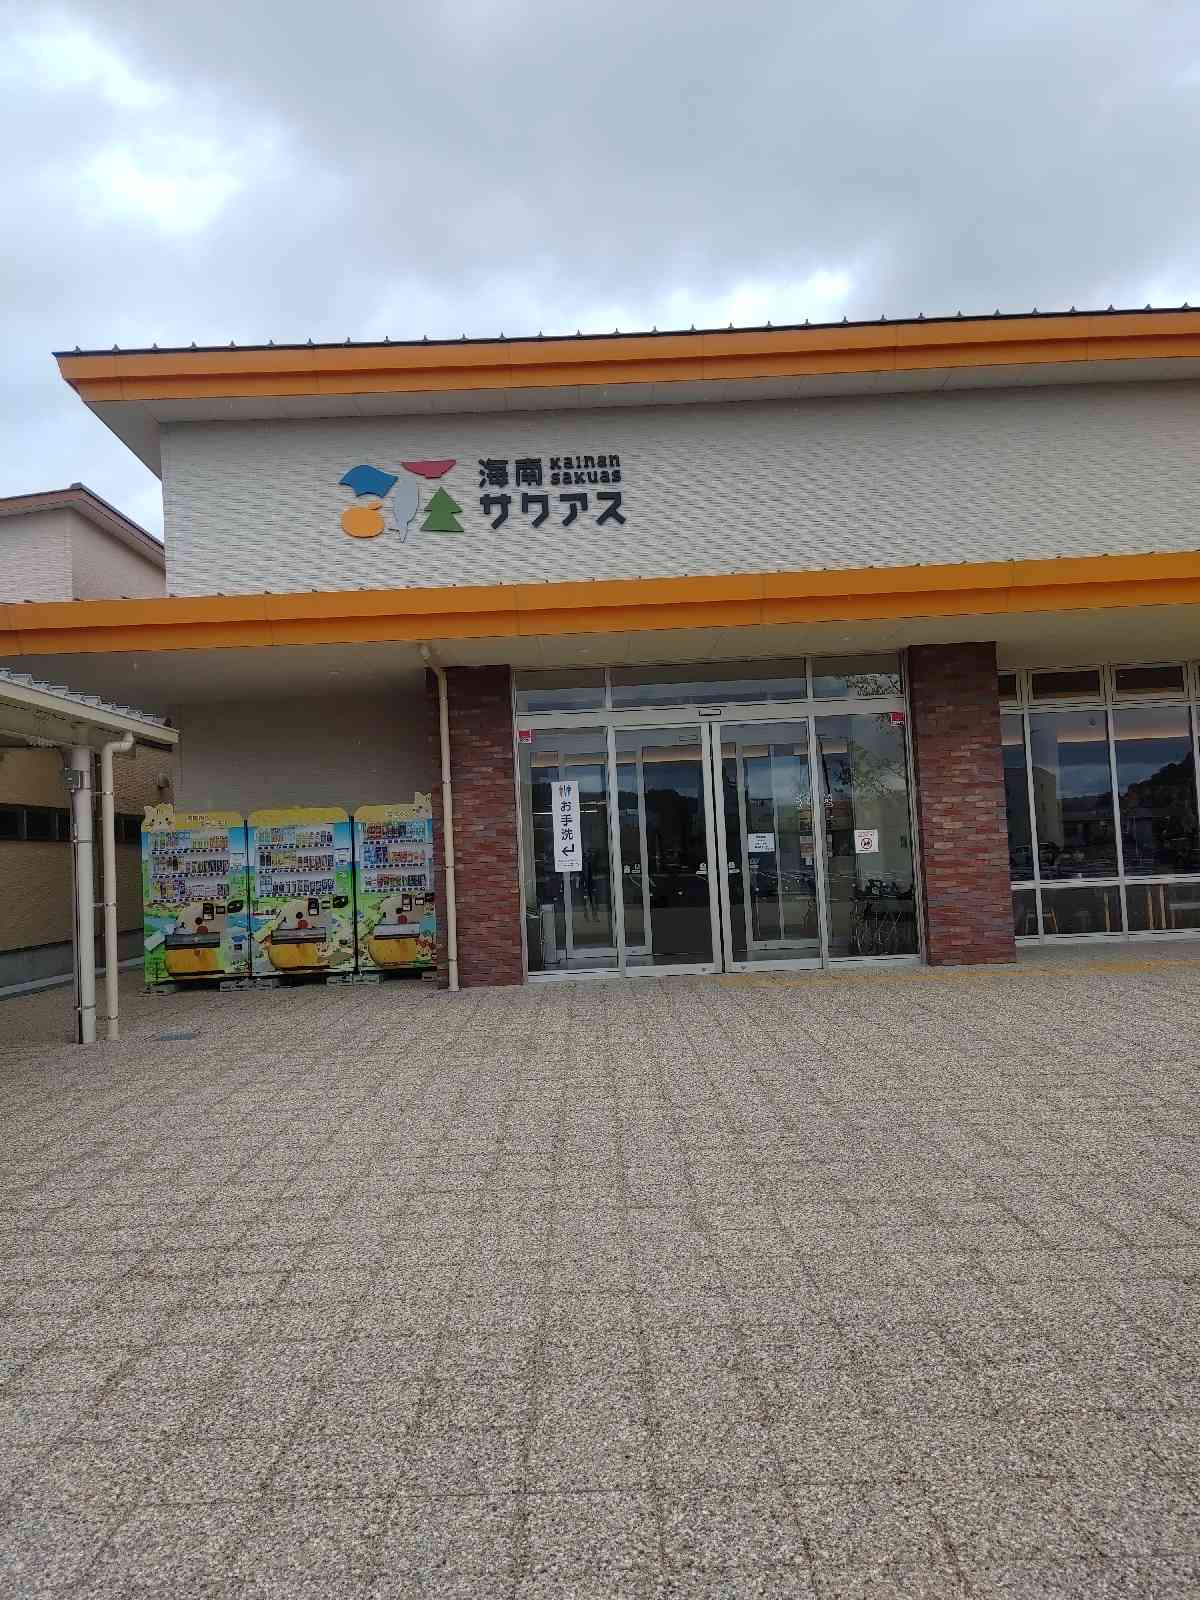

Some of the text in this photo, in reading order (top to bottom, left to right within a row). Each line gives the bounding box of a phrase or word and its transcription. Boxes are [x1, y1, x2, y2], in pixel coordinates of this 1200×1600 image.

[479, 457, 543, 487] 海南
[550, 454, 621, 470] kainan
[551, 470, 622, 485] sakuas
[479, 491, 626, 529] サクアス
[560, 800, 574, 841] お手洗
